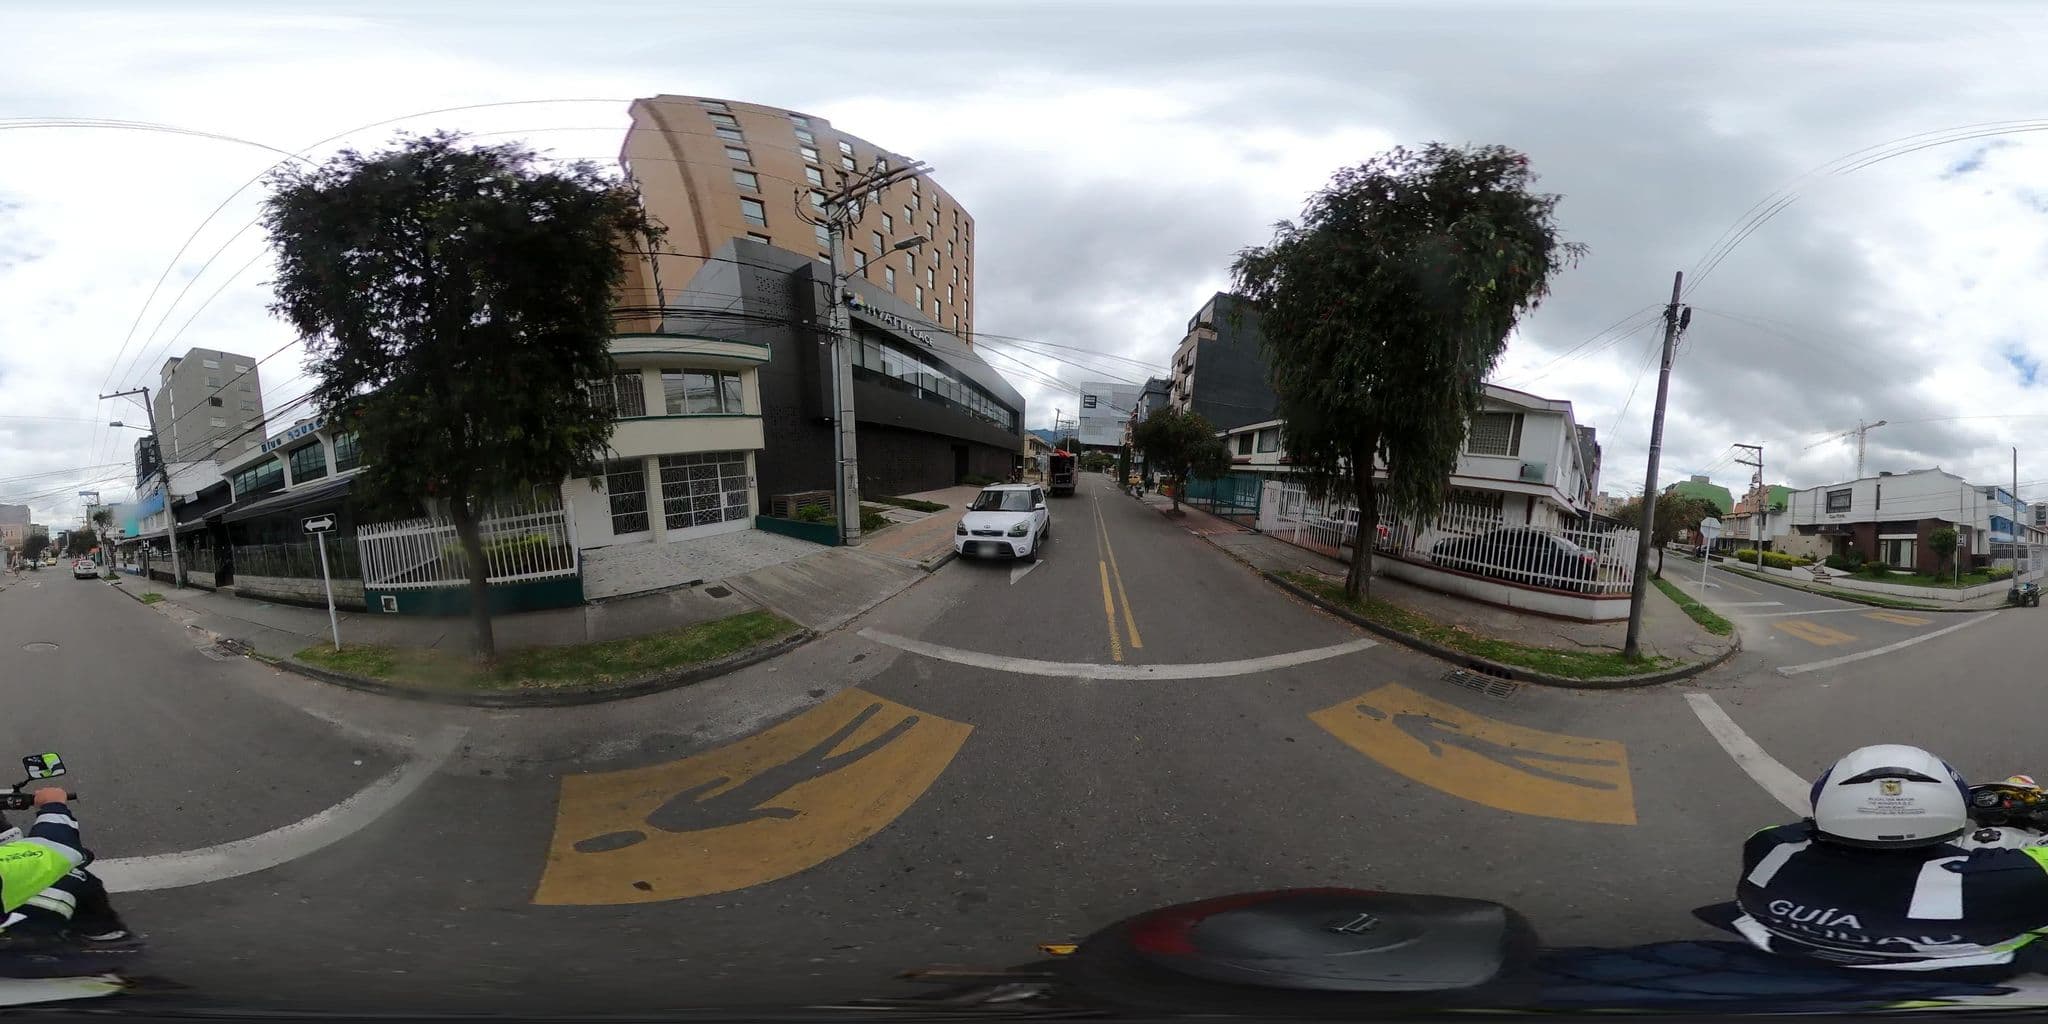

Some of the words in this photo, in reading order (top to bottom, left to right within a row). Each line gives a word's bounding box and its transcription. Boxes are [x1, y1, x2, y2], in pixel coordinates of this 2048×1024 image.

[906, 323, 935, 347] PLACE
[261, 438, 282, 453] Blue
[1768, 899, 1862, 930] GUÍA
